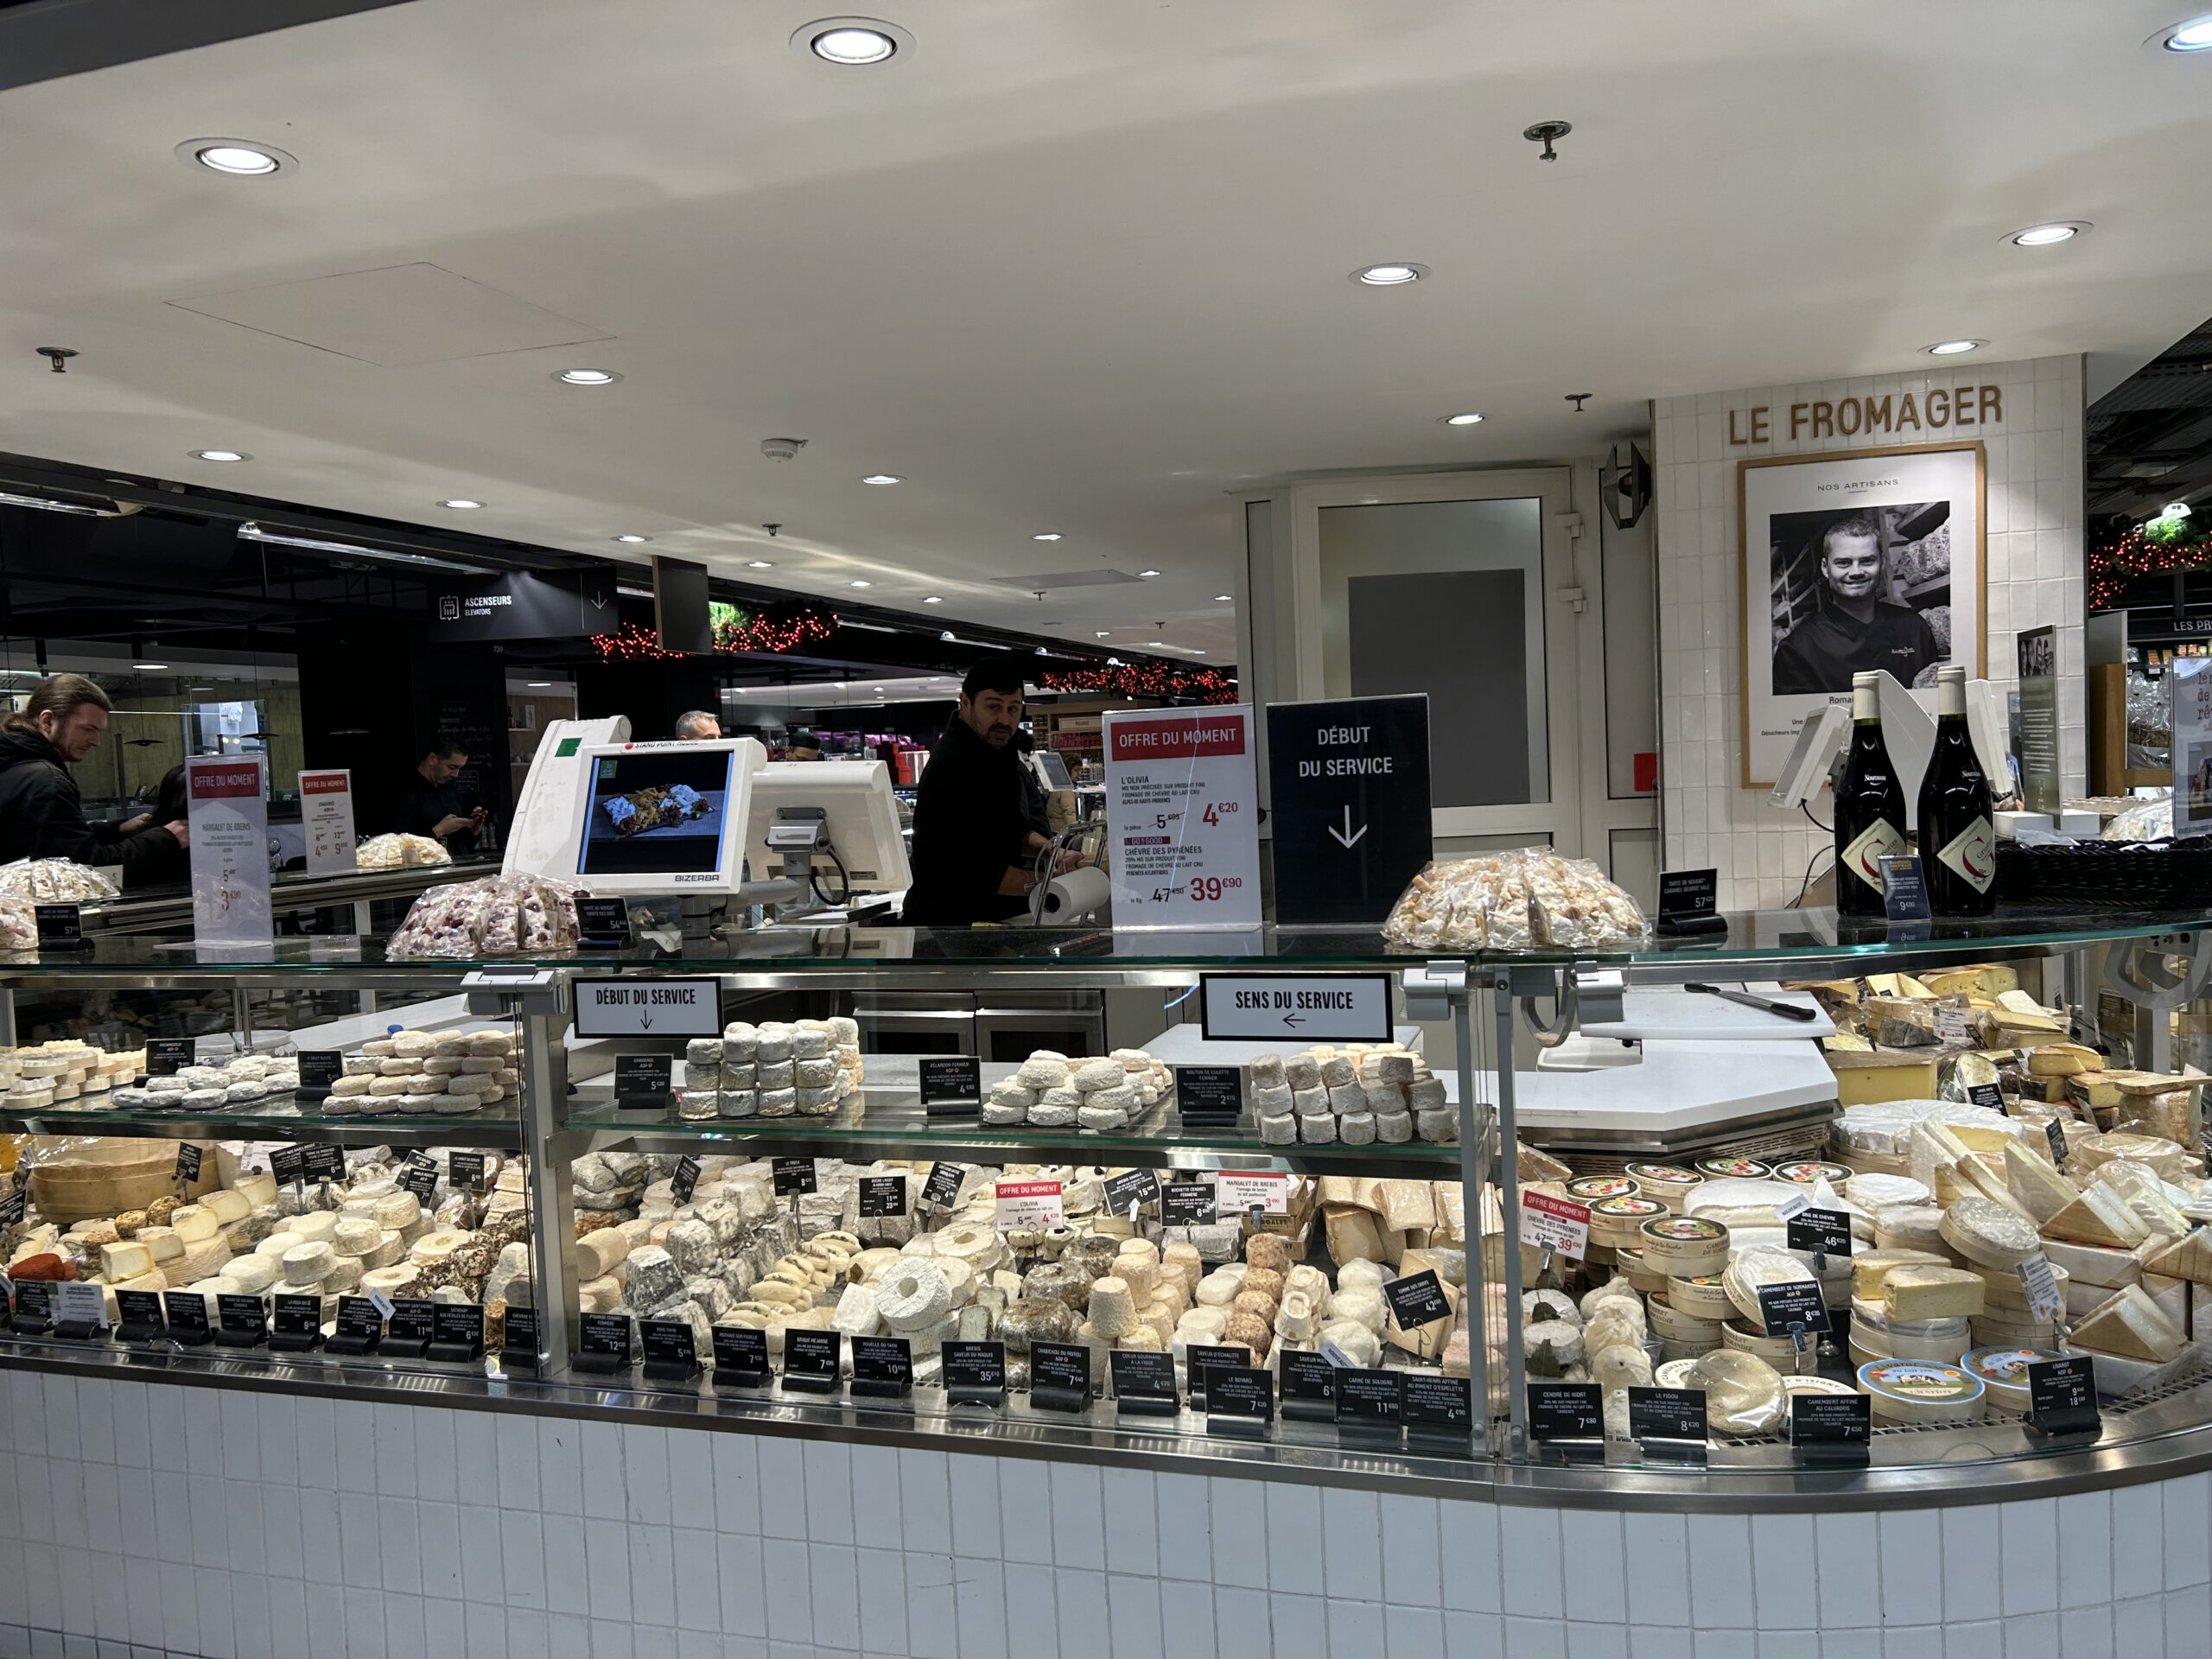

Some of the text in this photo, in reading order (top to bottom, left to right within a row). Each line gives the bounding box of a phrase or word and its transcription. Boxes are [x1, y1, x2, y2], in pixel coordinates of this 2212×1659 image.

[1729, 385, 2002, 445] LE FROMAGER
[1844, 479, 1899, 489] ARTISANS
[465, 595, 512, 607] ASCENSEURS
[2173, 620, 2212, 632] LES PR
[1829, 696, 1853, 704] Romai
[1119, 728, 1236, 747] OFFRE DU MOMENT
[1317, 726, 1370, 746] DÉBUT
[1299, 757, 1393, 777] DU SERVICE
[194, 773, 256, 787] OFFRE DU MOMENT
[1122, 776, 1149, 785] L'OLIVIA
[226, 823, 233, 831] DE
[1153, 847, 1166, 855] DES
[674, 874, 720, 882] BIZERBA
[596, 987, 696, 1005] DÉBUT DU SERVICE
[1236, 991, 1354, 1009] SENS DU SERVICE
[999, 1185, 1020, 1194] OFFRE
[1031, 1184, 1057, 1193] MOMENT
[1528, 1194, 1587, 1219] OFFRE DU MOMENT
